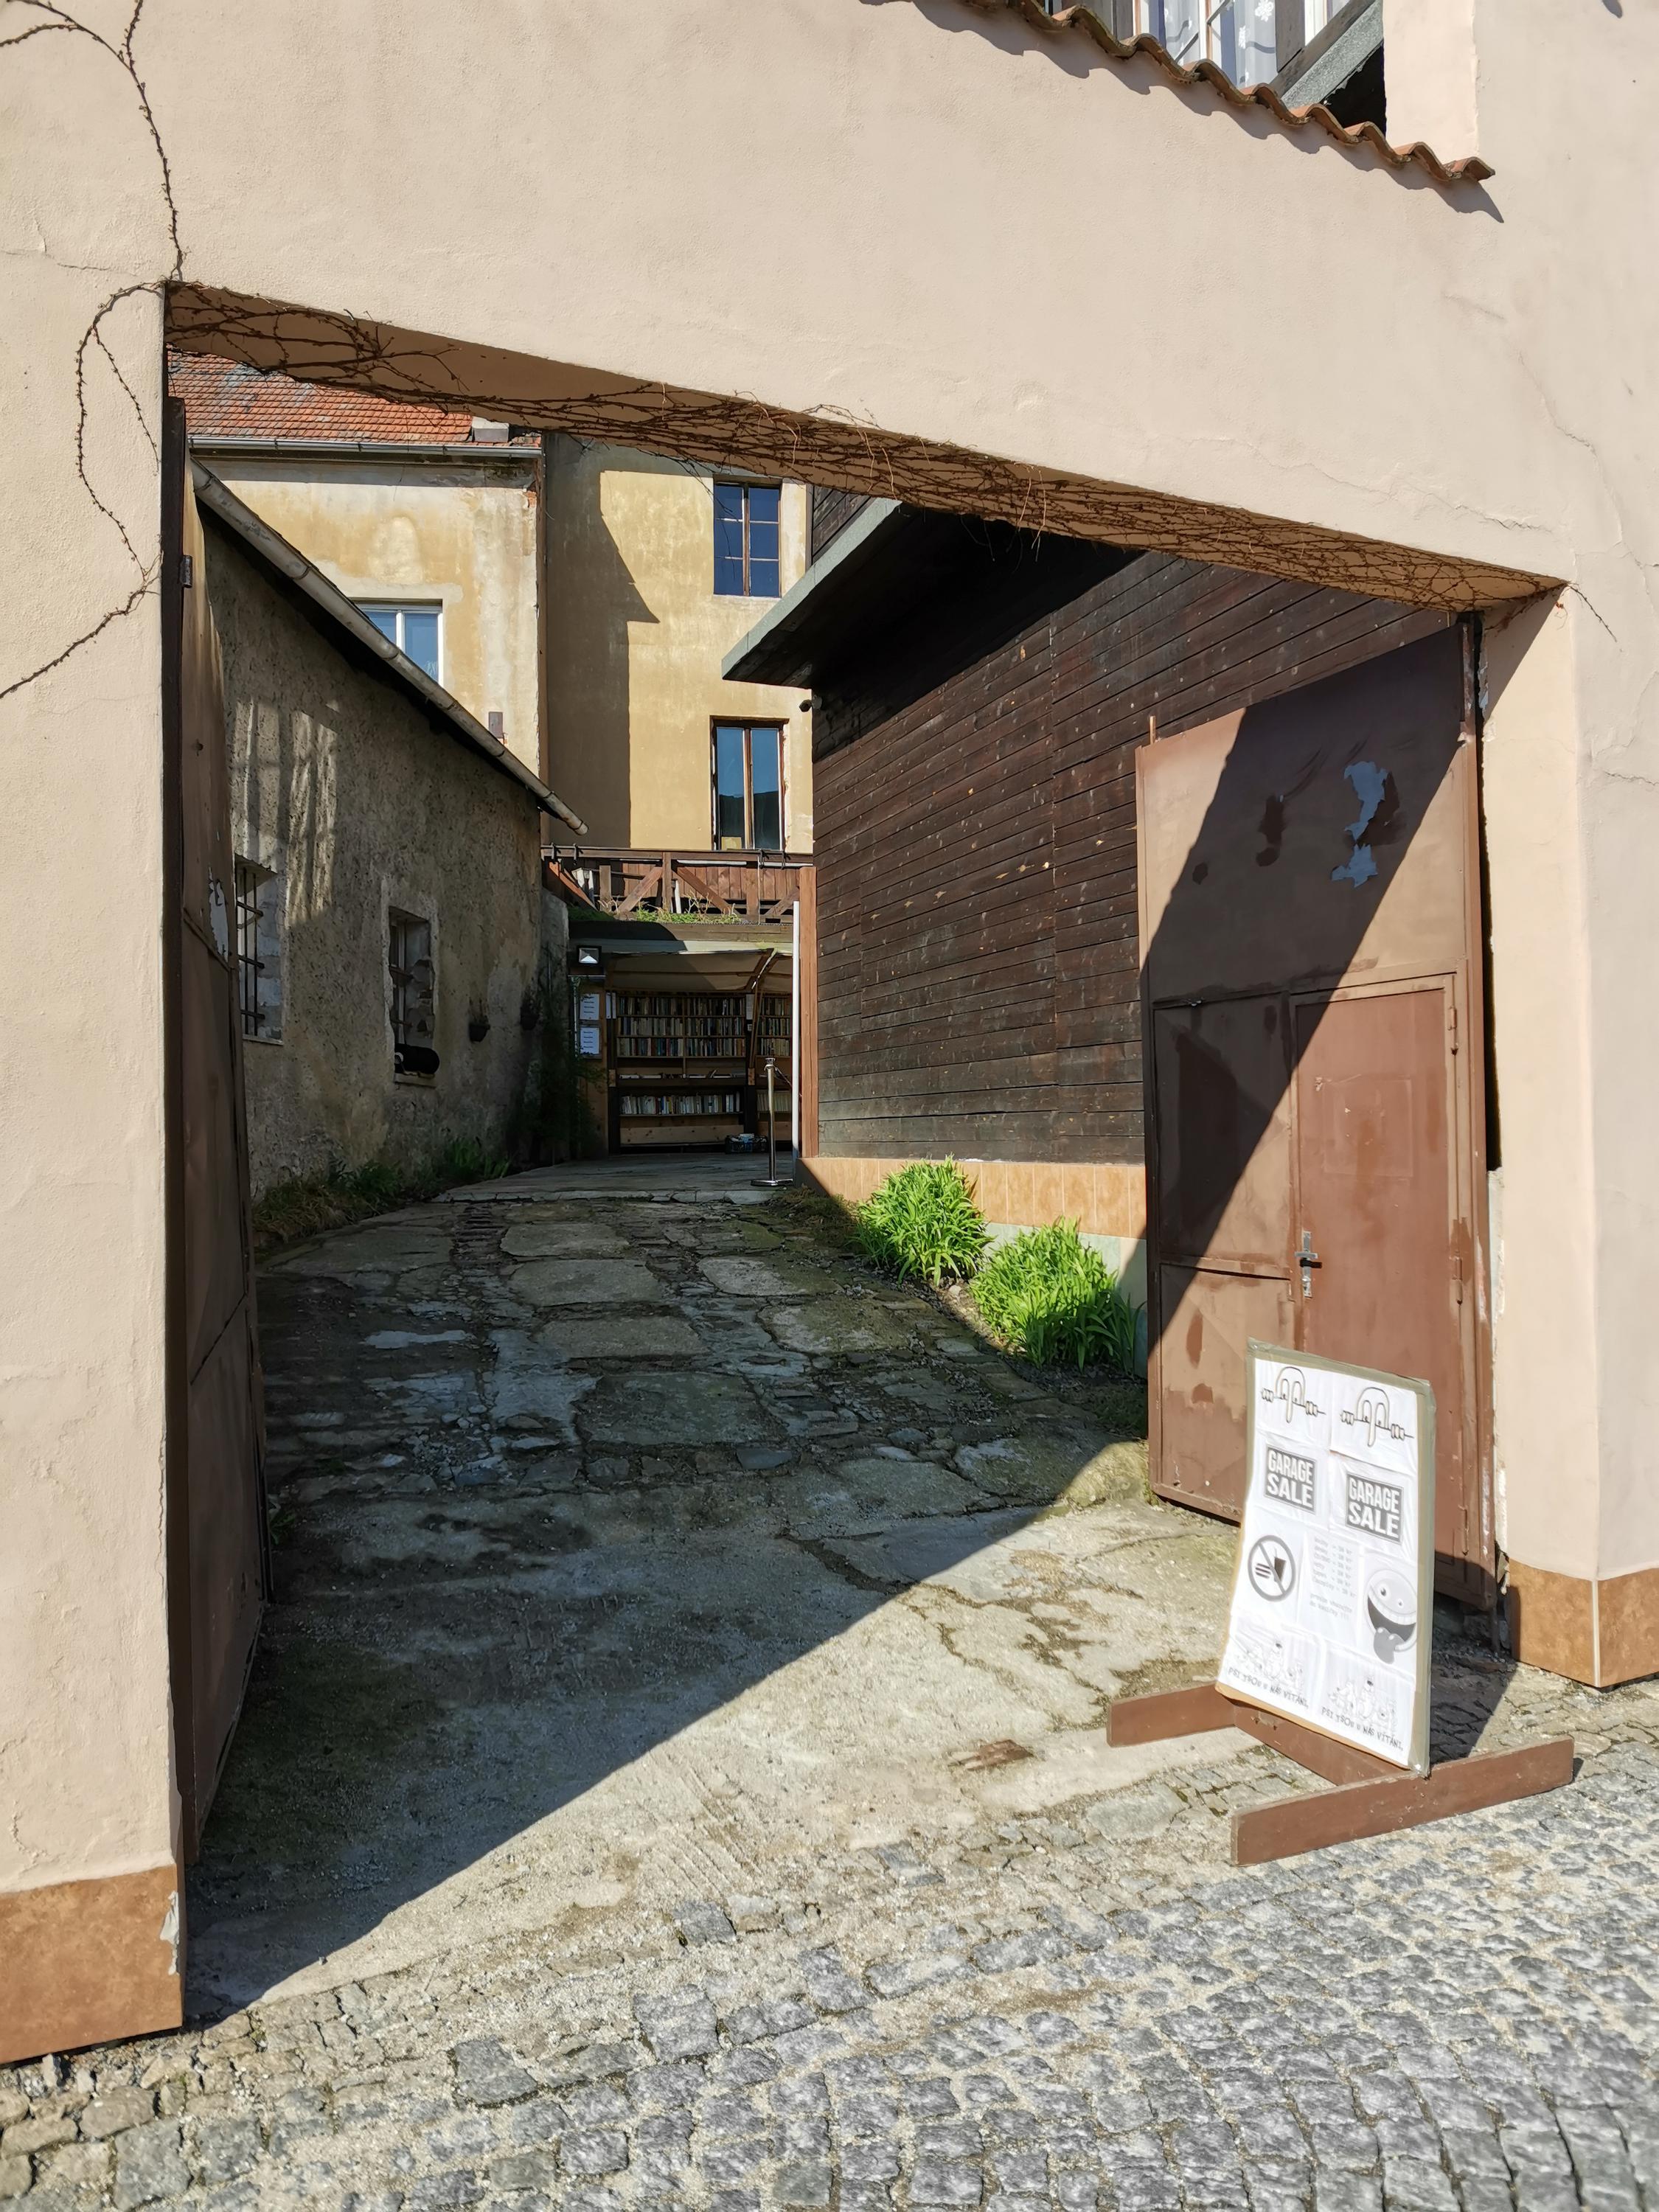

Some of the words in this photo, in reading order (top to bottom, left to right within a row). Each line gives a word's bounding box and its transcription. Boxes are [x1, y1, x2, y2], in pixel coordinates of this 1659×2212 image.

[1267, 1450, 1313, 1485] GARAGE
[1267, 1472, 1313, 1508] SALE
[1349, 1477, 1399, 1514] GARAGE
[1348, 1502, 1399, 1538] SALE
[1321, 1706, 1333, 1719] PSI
